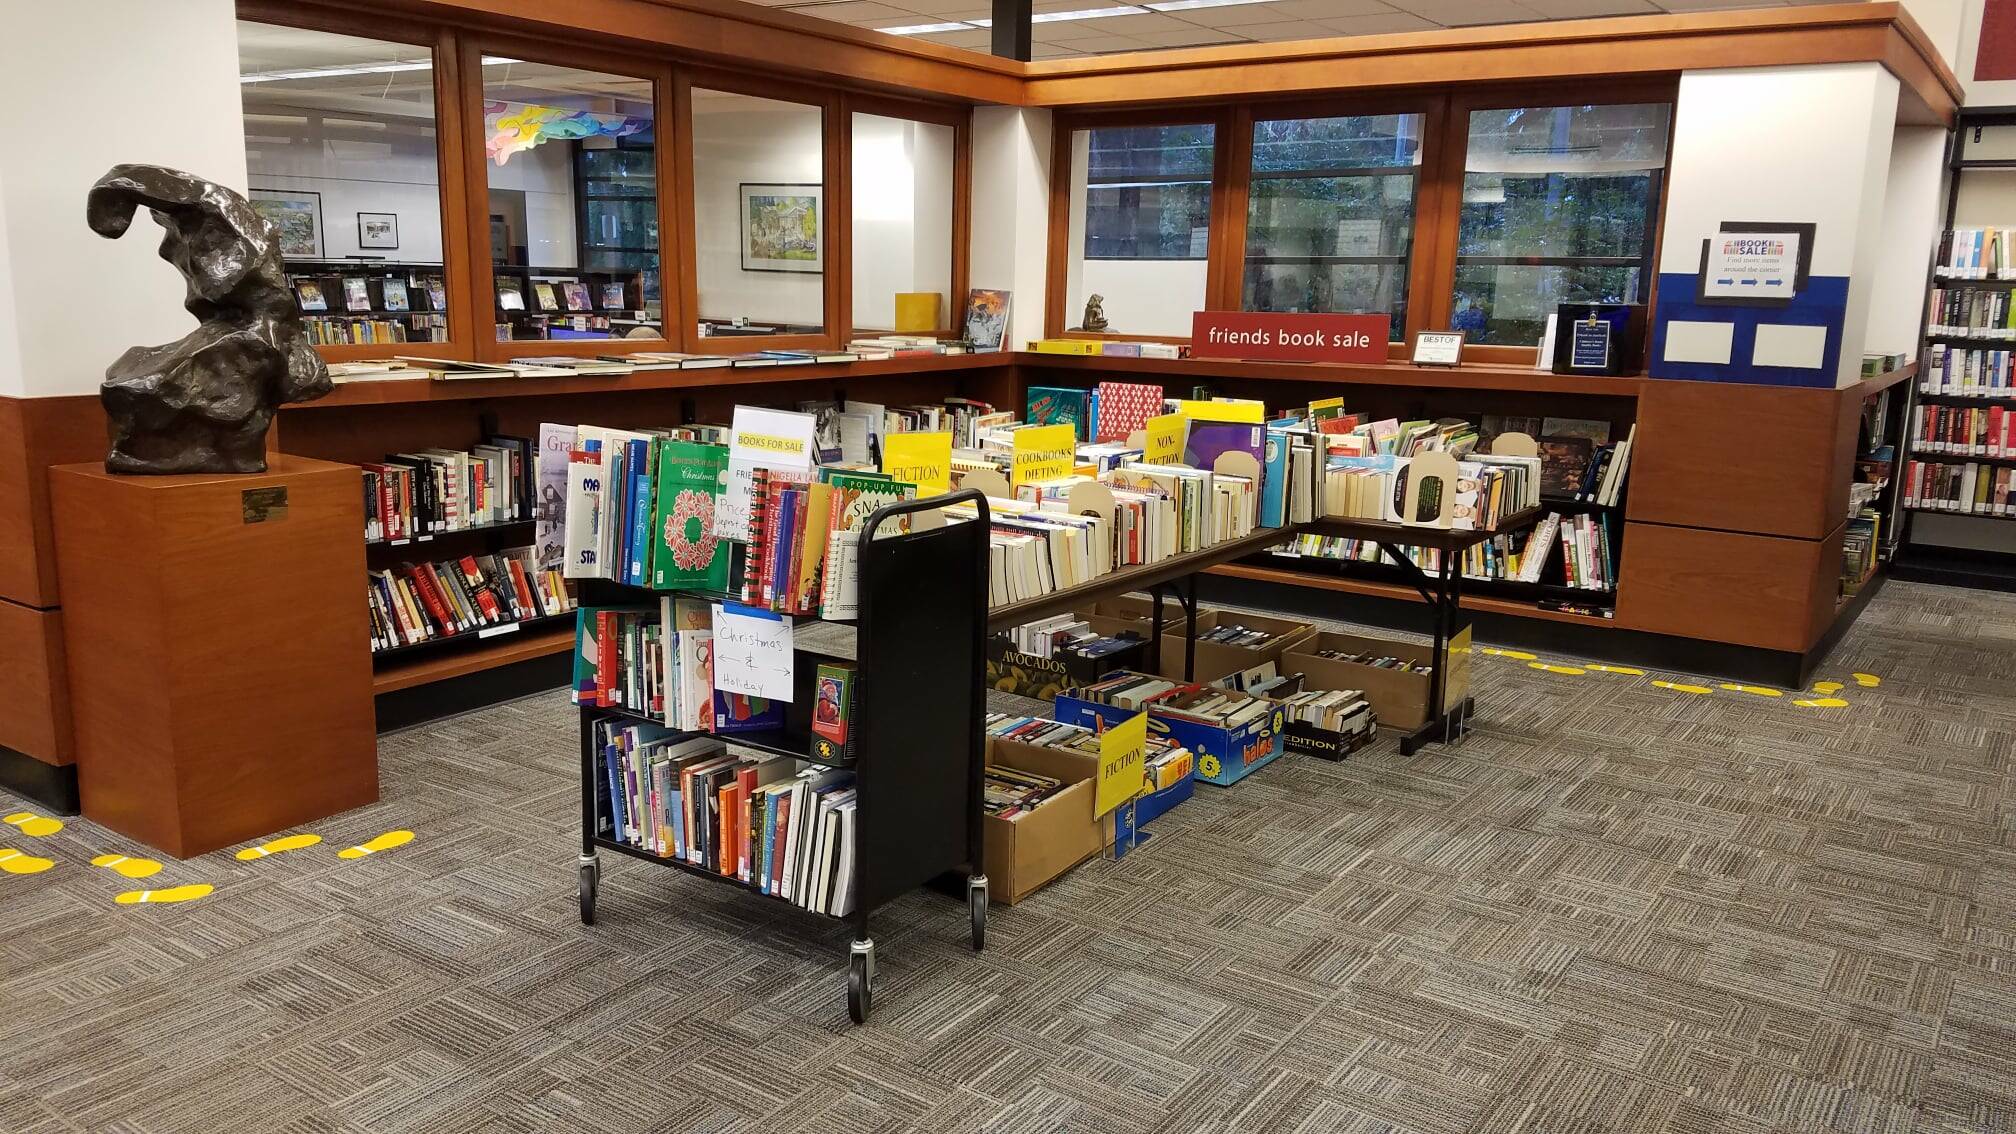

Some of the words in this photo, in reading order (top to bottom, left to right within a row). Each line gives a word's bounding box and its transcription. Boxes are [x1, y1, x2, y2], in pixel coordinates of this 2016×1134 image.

[1739, 247, 1767, 255] SALE
[1208, 327, 1271, 345] friends
[1278, 329, 1325, 347] book
[1332, 331, 1370, 348] sale
[547, 436, 578, 452] Gra
[738, 435, 765, 447] BOOKS
[767, 439, 783, 449] FOR
[785, 442, 804, 453] SALE
[1016, 447, 1072, 465] COOKBOOKS
[1148, 453, 1180, 465] FICTION
[735, 470, 752, 480] FRIE
[770, 471, 802, 481] NIGELLA
[893, 465, 941, 482] FICTION
[1025, 464, 1063, 481] DIETING
[583, 478, 600, 491] MA
[850, 481, 885, 490] POP-UP
[749, 481, 758, 521] NIGELLA
[854, 498, 881, 517] SNA
[744, 524, 755, 578] CHRISTMAS
[719, 626, 784, 652] Christmas
[1002, 649, 1066, 674] AVOCADOS
[723, 673, 764, 697] Holiday
[1284, 734, 1336, 751] EDITION
[1243, 736, 1273, 768] halos
[1105, 746, 1141, 779] FICTION
[1205, 760, 1214, 771] 5
